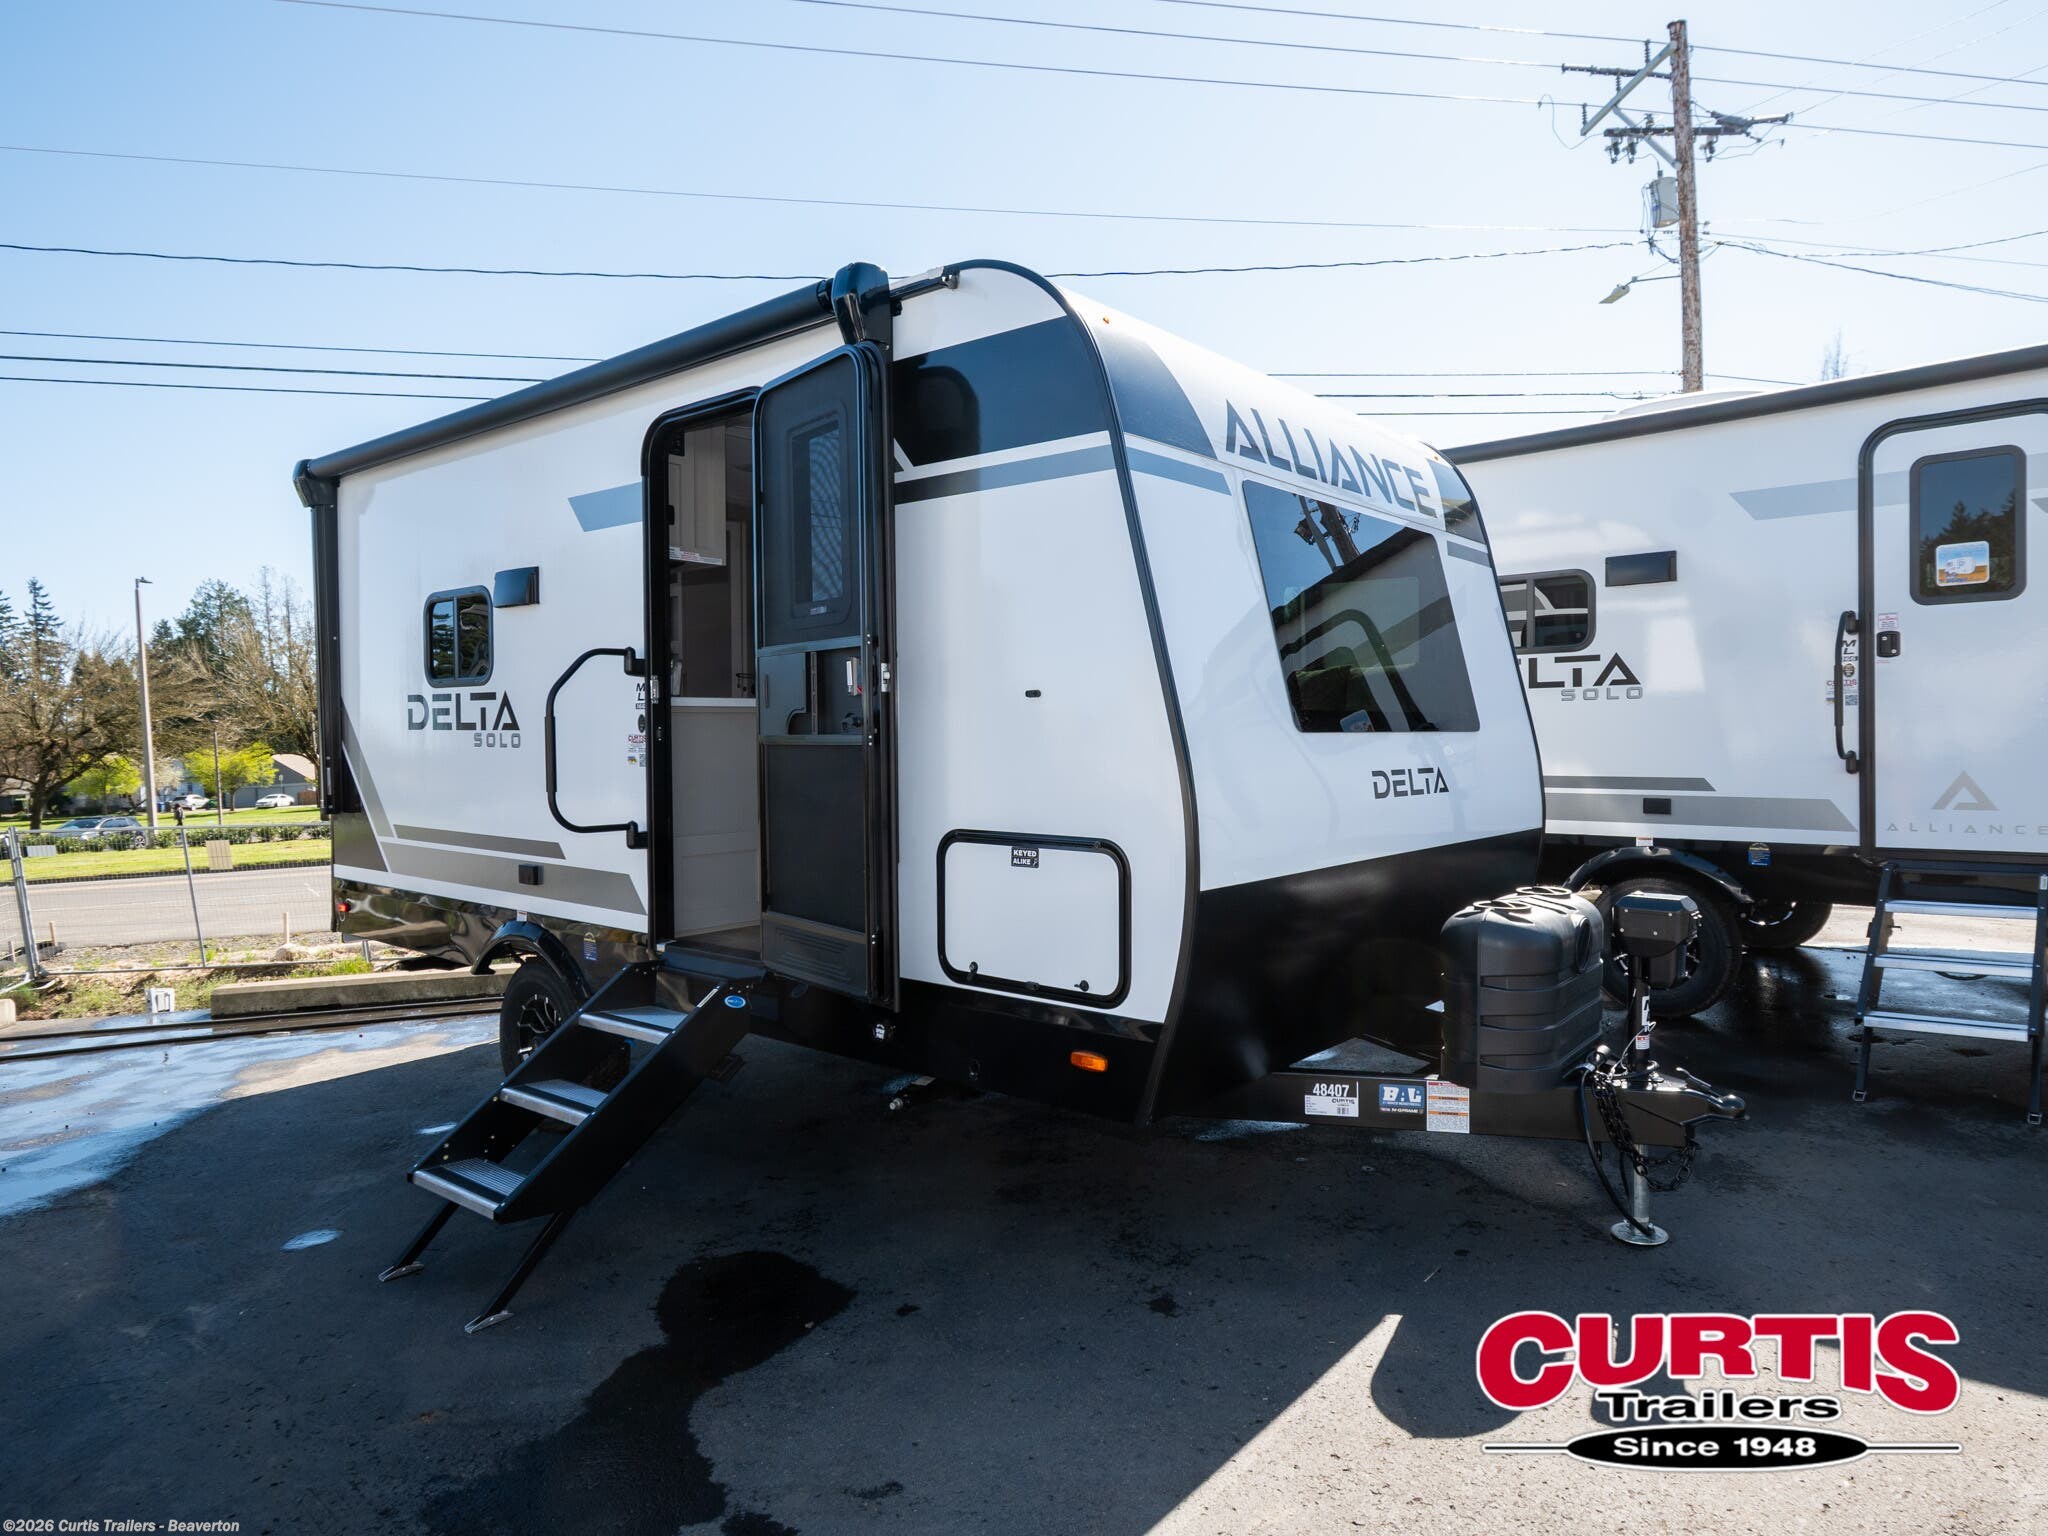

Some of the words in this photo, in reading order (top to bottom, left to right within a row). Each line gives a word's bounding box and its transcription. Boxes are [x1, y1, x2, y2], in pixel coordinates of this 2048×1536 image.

[1226, 399, 1438, 519] ALLIANCE
[1518, 652, 1642, 689] LTA
[1561, 686, 1643, 702] SOLO
[407, 690, 520, 731] DELTA
[473, 732, 521, 748] SOLO
[1371, 766, 1450, 799] DELTA
[1887, 823, 2048, 836] ALLIANCE
[1012, 857, 1031, 865] ALIKE
[1013, 849, 1037, 857] KEYED
[1312, 1082, 1350, 1098] 48407
